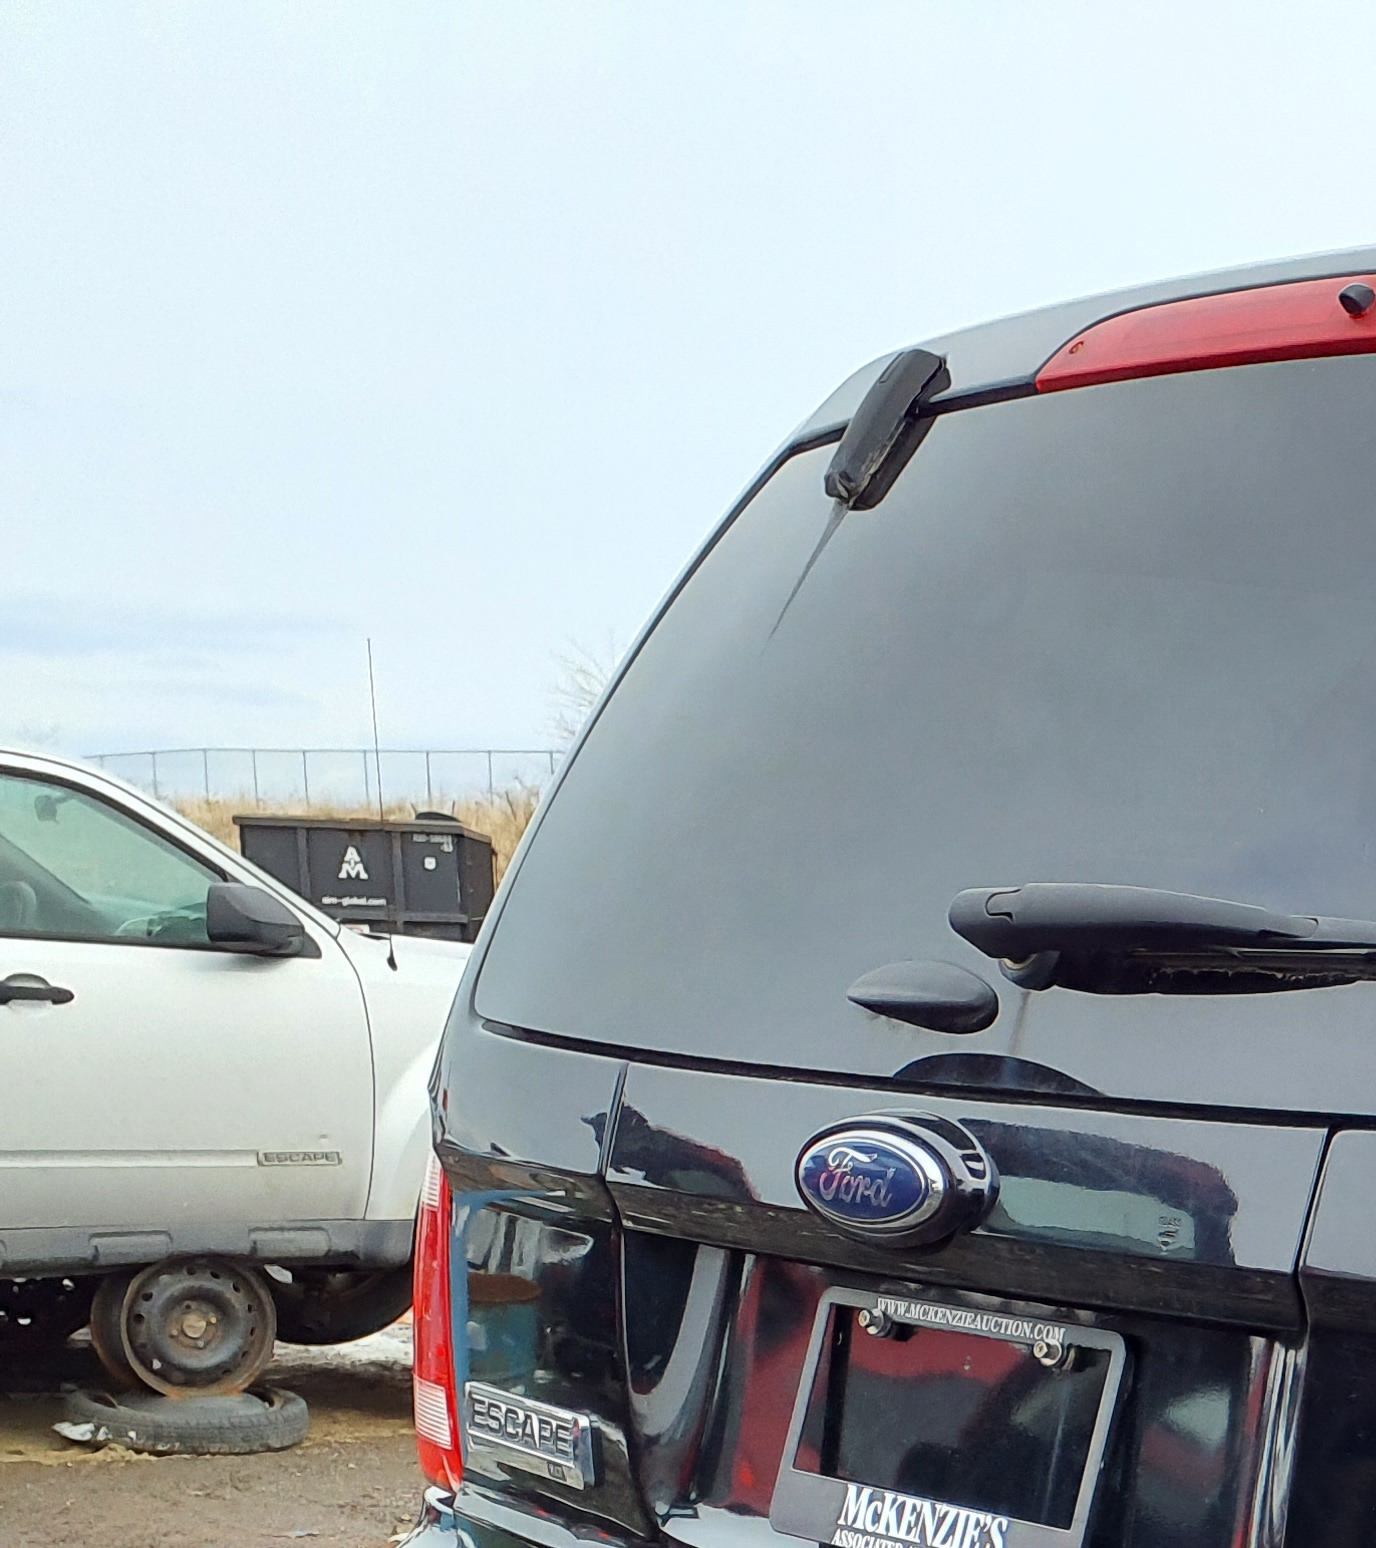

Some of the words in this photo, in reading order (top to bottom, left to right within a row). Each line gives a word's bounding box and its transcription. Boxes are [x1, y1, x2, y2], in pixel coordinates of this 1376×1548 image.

[263, 1152, 338, 1164] ESCAPE
[819, 1146, 893, 1208] Ford
[877, 1297, 1066, 1343] WWW.MCKENZIEAUCTION.COM
[470, 1393, 575, 1457] ESCAPE
